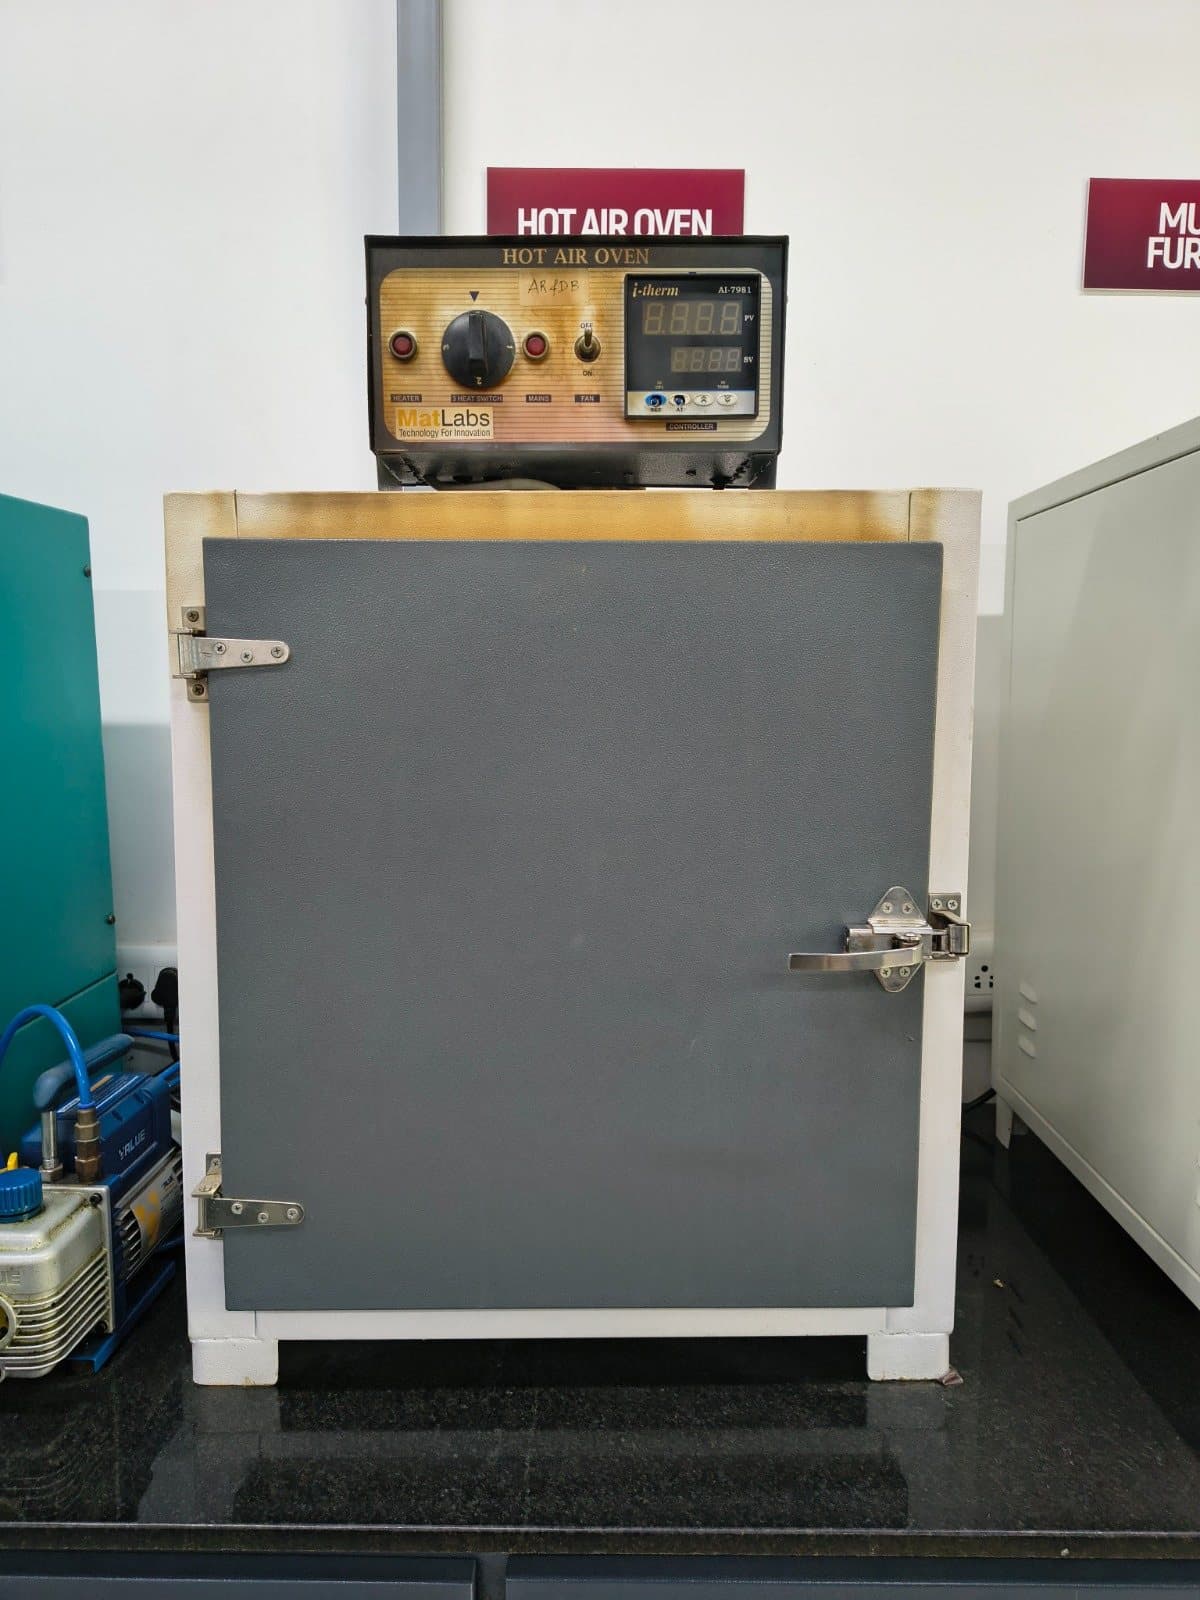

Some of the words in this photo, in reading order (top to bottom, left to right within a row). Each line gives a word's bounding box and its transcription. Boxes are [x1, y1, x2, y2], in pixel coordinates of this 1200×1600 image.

[517, 207, 577, 235] HOT
[581, 208, 629, 235] AIR
[633, 208, 713, 236] OVEN
[502, 248, 547, 264] HOT
[554, 248, 588, 264] AIR
[594, 248, 649, 264] OVEN
[1146, 236, 1200, 269] FUR
[632, 282, 679, 297] i-therm
[718, 286, 752, 294] AI-7981
[397, 408, 490, 427] MatLabs
[399, 428, 439, 438] Technology
[441, 428, 452, 437] For
[454, 428, 490, 437] Innovation
